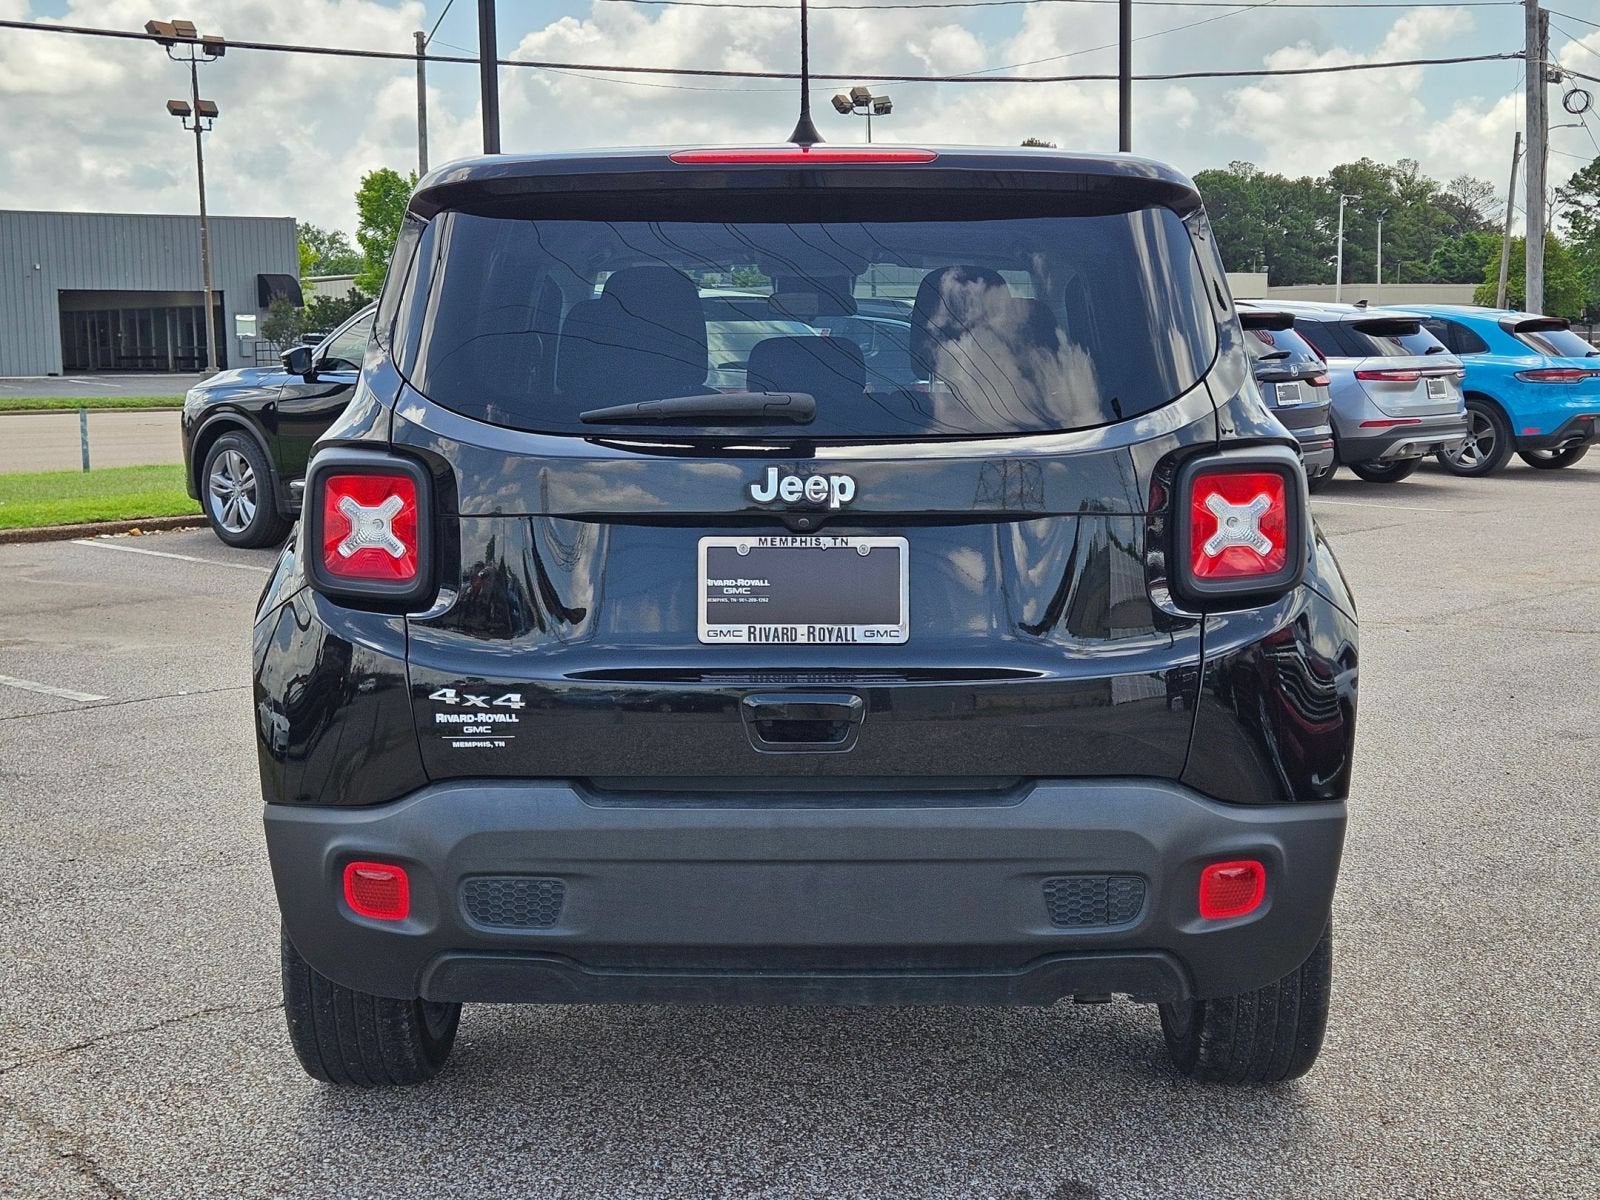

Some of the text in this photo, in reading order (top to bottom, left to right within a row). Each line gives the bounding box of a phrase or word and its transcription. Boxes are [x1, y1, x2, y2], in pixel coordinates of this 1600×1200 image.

[750, 467, 856, 509] Jeep
[758, 537, 849, 547] MEMPHIS, TN
[707, 630, 743, 638] GMC
[864, 630, 900, 638] GMC
[435, 713, 519, 722] RIVARD-ROYALL
